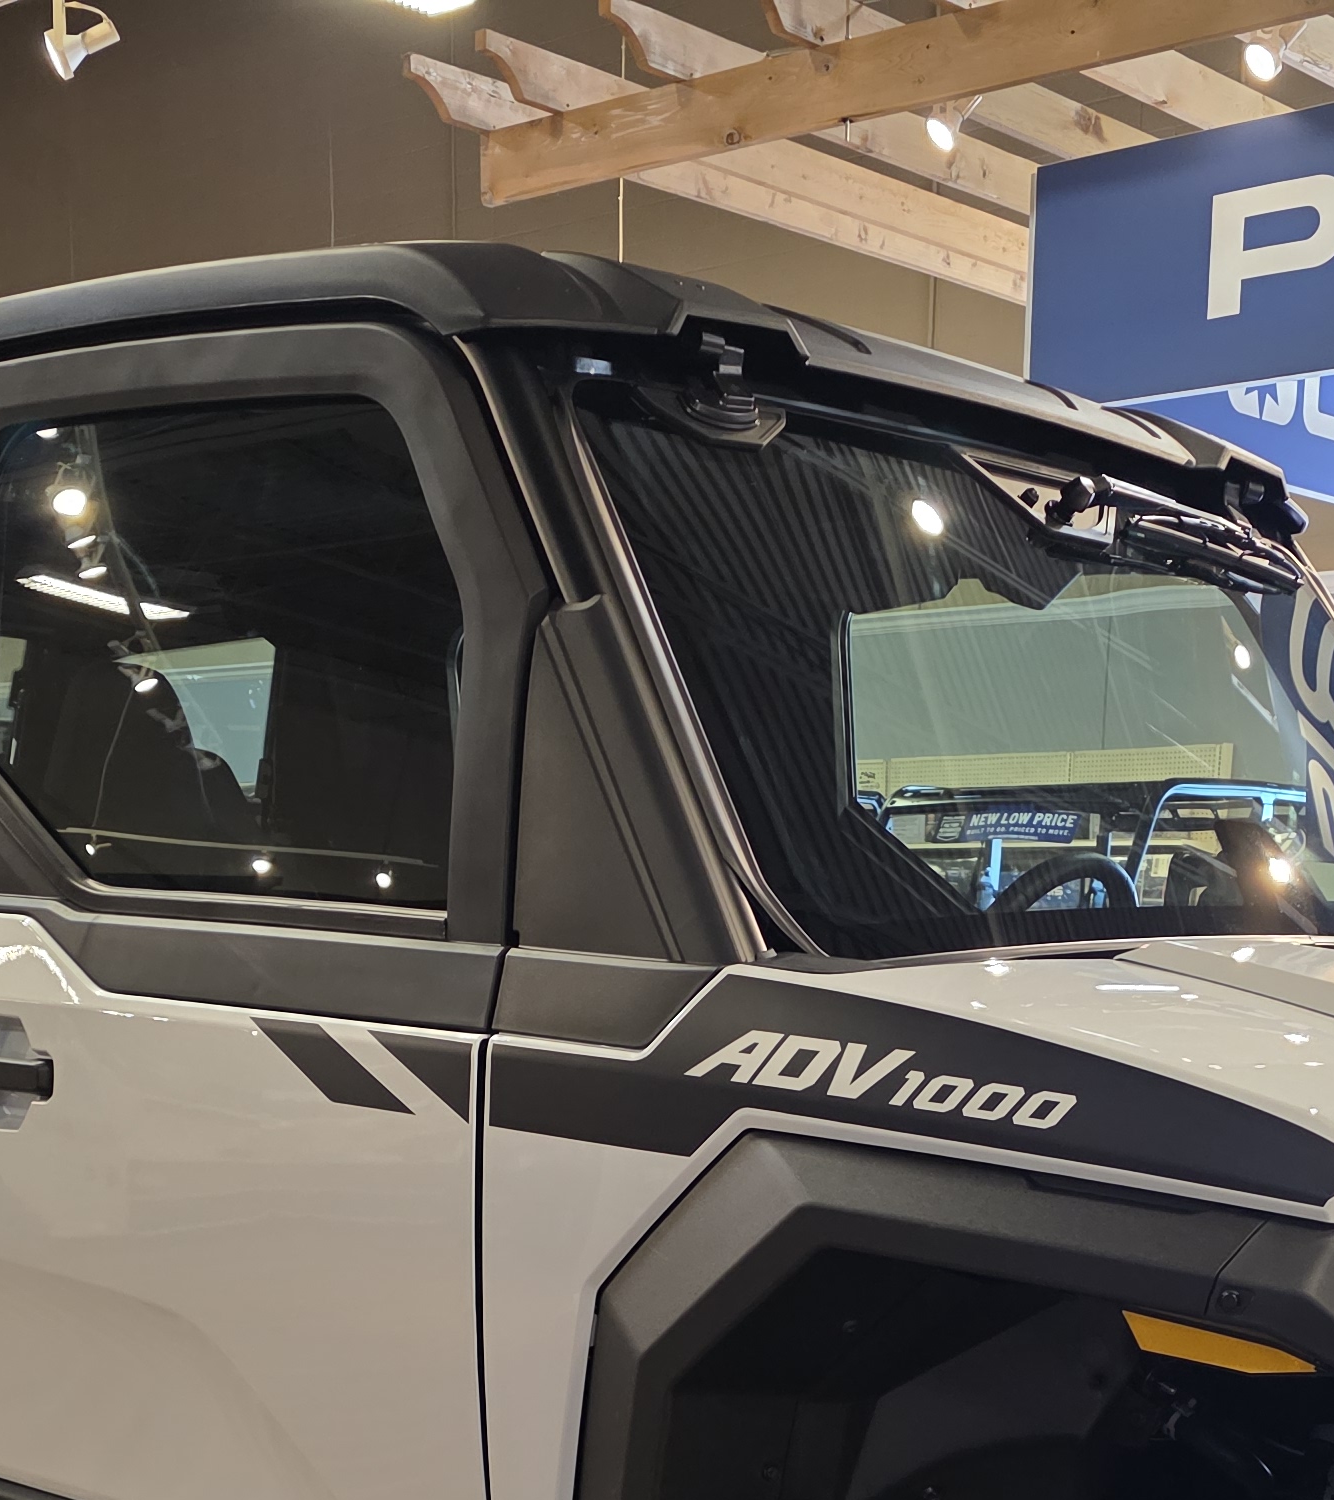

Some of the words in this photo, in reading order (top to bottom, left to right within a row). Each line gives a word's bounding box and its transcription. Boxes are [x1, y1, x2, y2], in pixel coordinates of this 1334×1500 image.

[969, 813, 1000, 827] NEW
[1001, 812, 1032, 825] LOW
[1033, 812, 1078, 828] PRICE
[684, 1030, 916, 1099] ADV
[888, 1070, 1078, 1129] 1000
